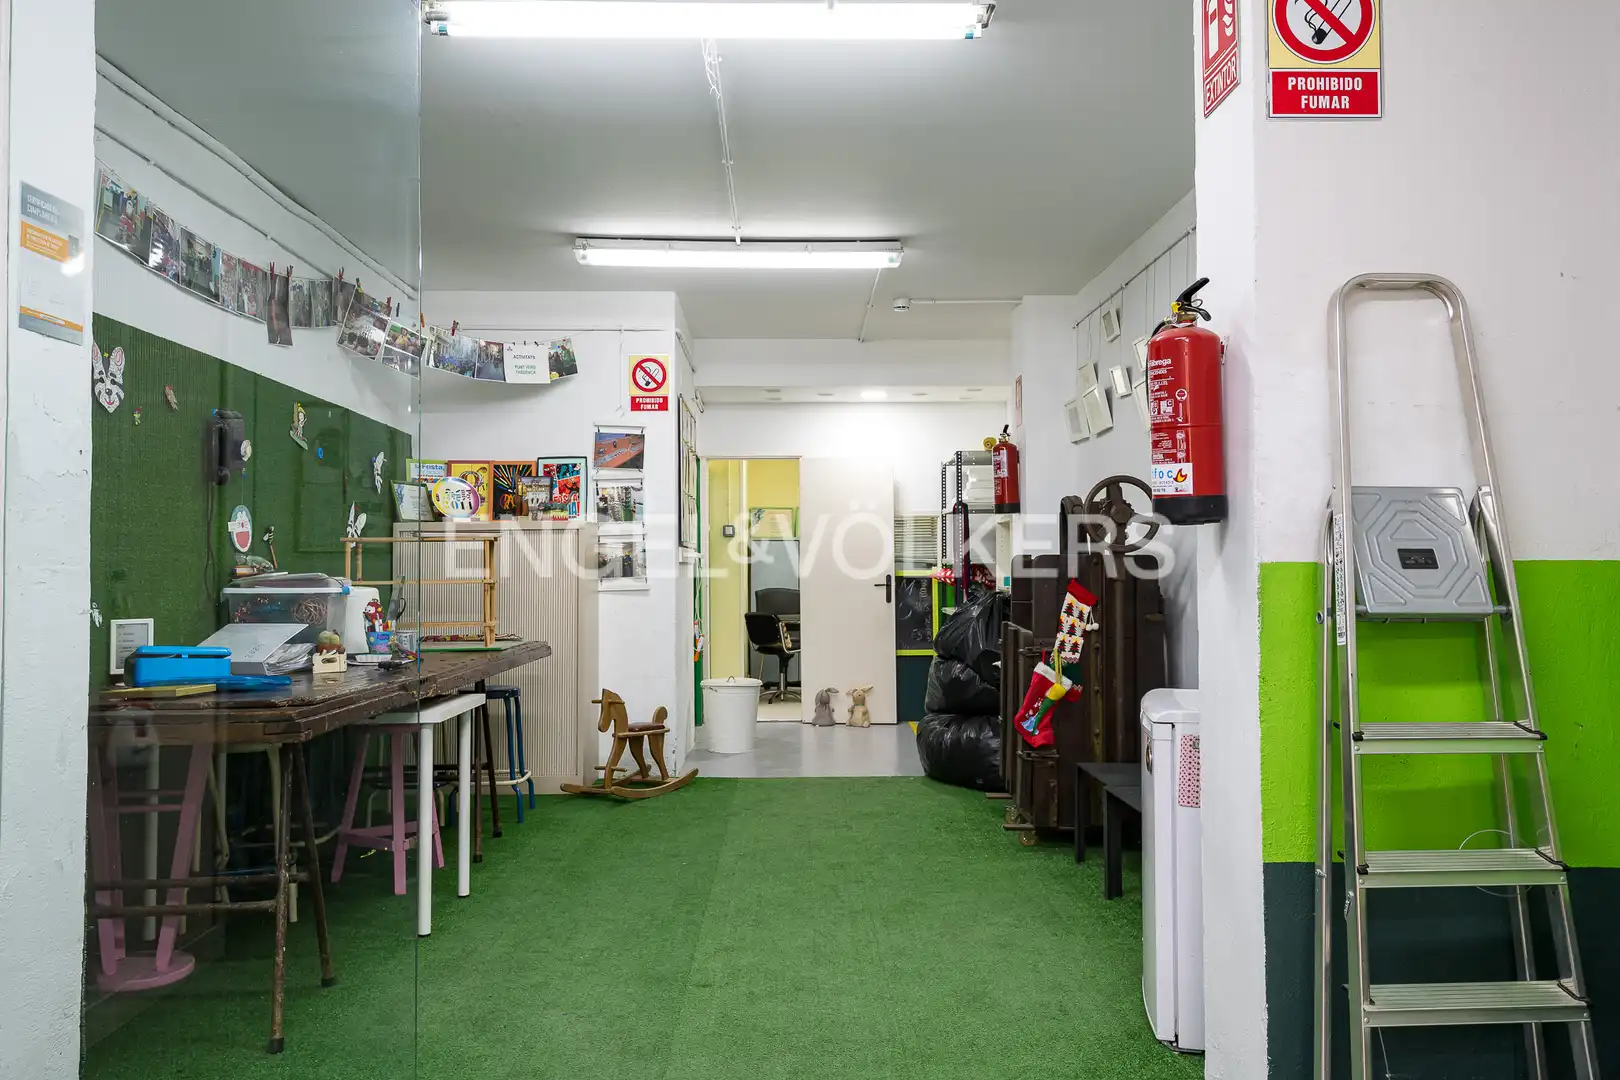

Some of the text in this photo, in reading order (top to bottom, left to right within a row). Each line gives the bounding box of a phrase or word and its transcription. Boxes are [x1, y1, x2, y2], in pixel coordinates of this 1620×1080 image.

[1206, 60, 1237, 107] EXTINTOR
[1288, 76, 1363, 91] PROHIBIDO
[1301, 95, 1350, 109] FUMAR
